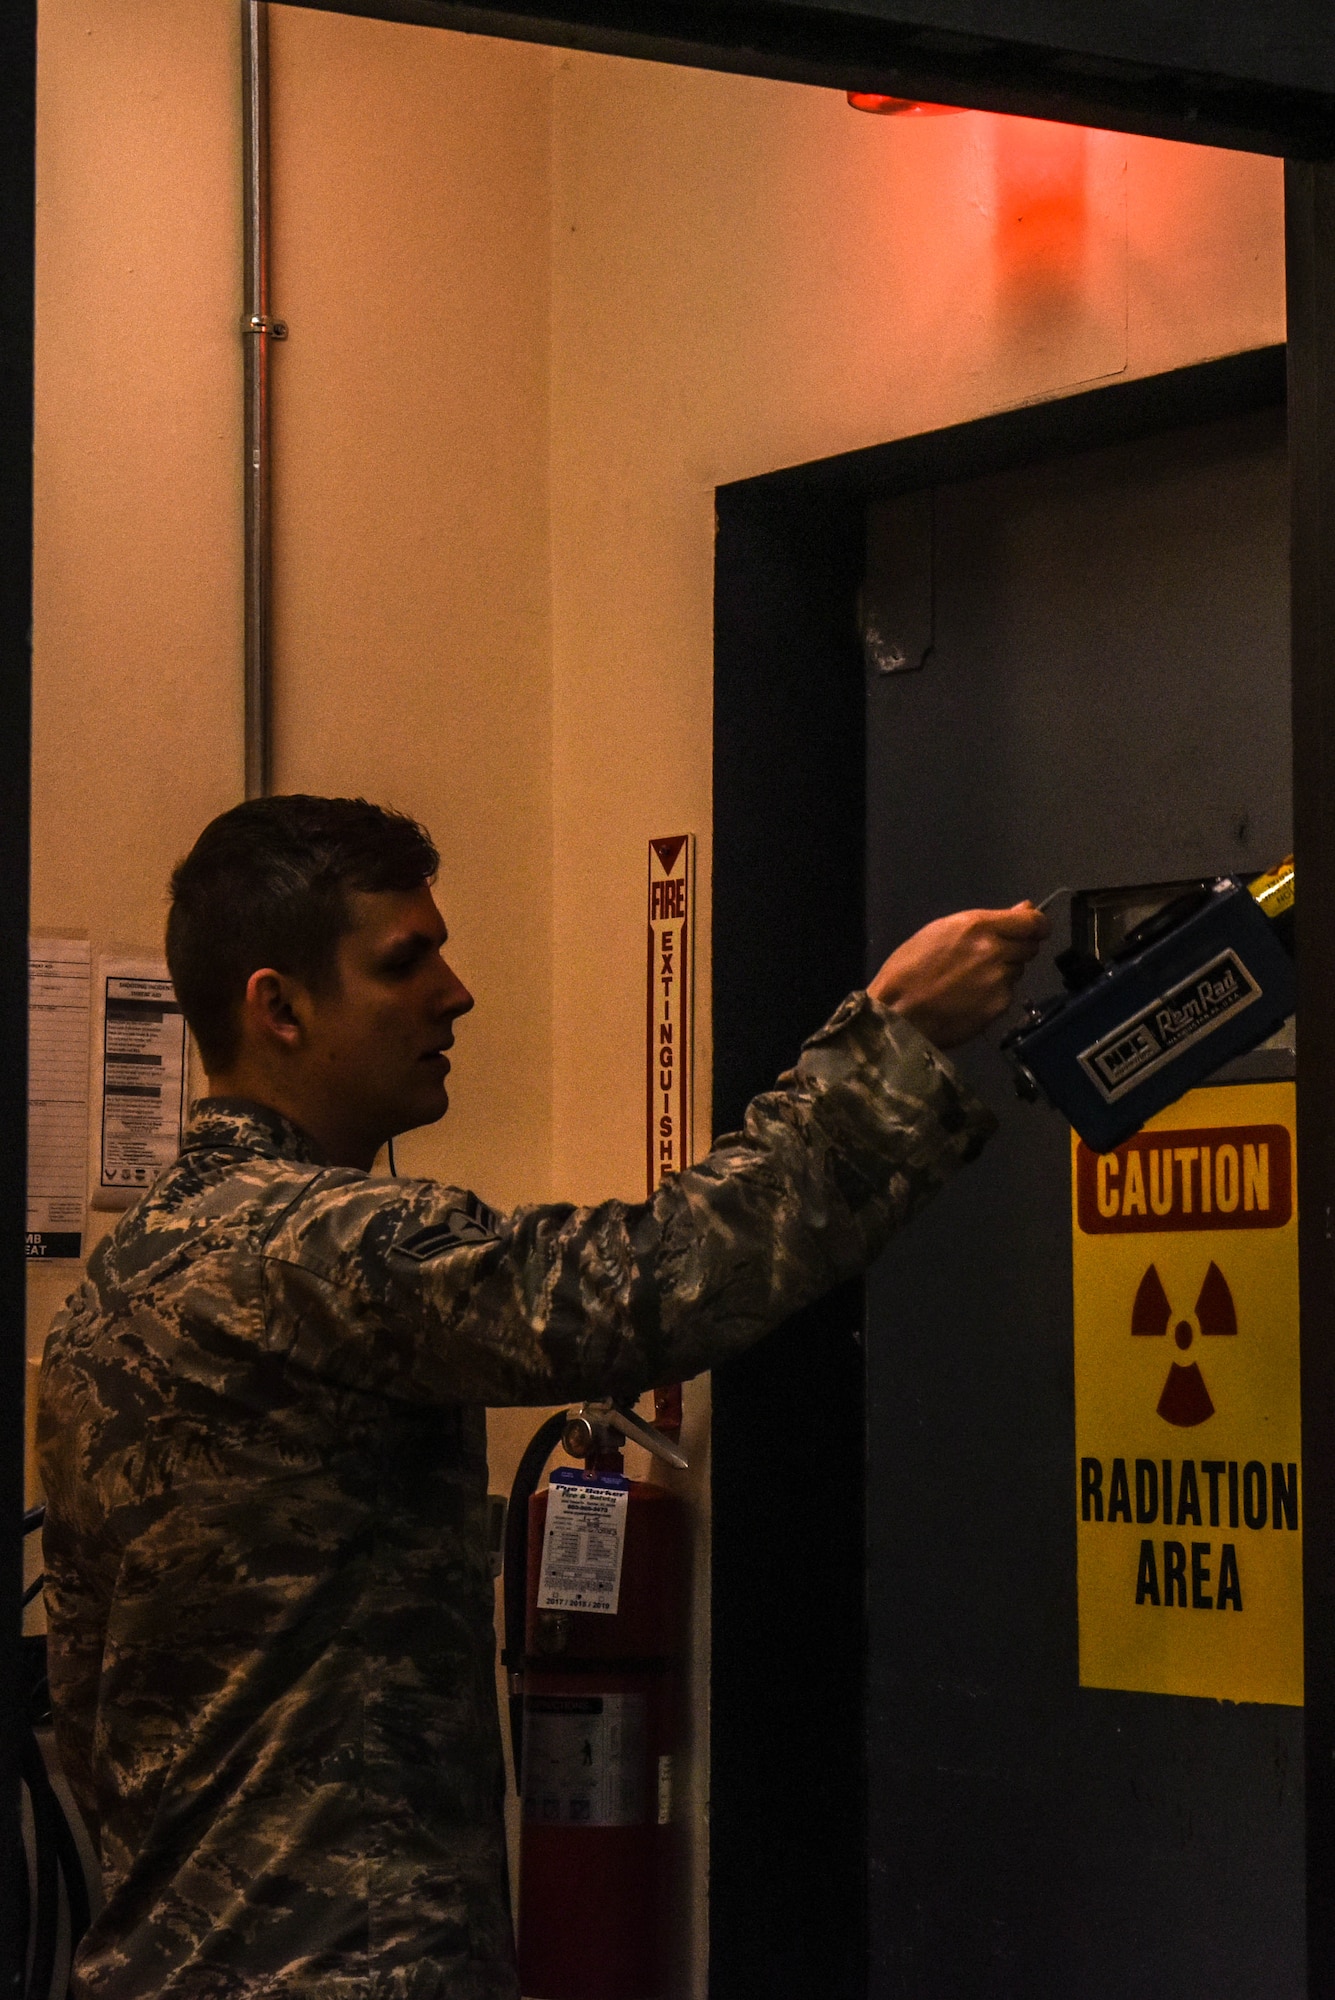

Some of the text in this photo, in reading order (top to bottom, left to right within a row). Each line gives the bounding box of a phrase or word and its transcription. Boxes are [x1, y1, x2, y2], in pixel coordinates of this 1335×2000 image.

[652, 878, 685, 920] FIRE
[1096, 1143, 1271, 1218] CAUTION
[1080, 1456, 1298, 1531] RADIATION
[592, 1602, 609, 1610] 2019
[1135, 1539, 1243, 1612] AREA
